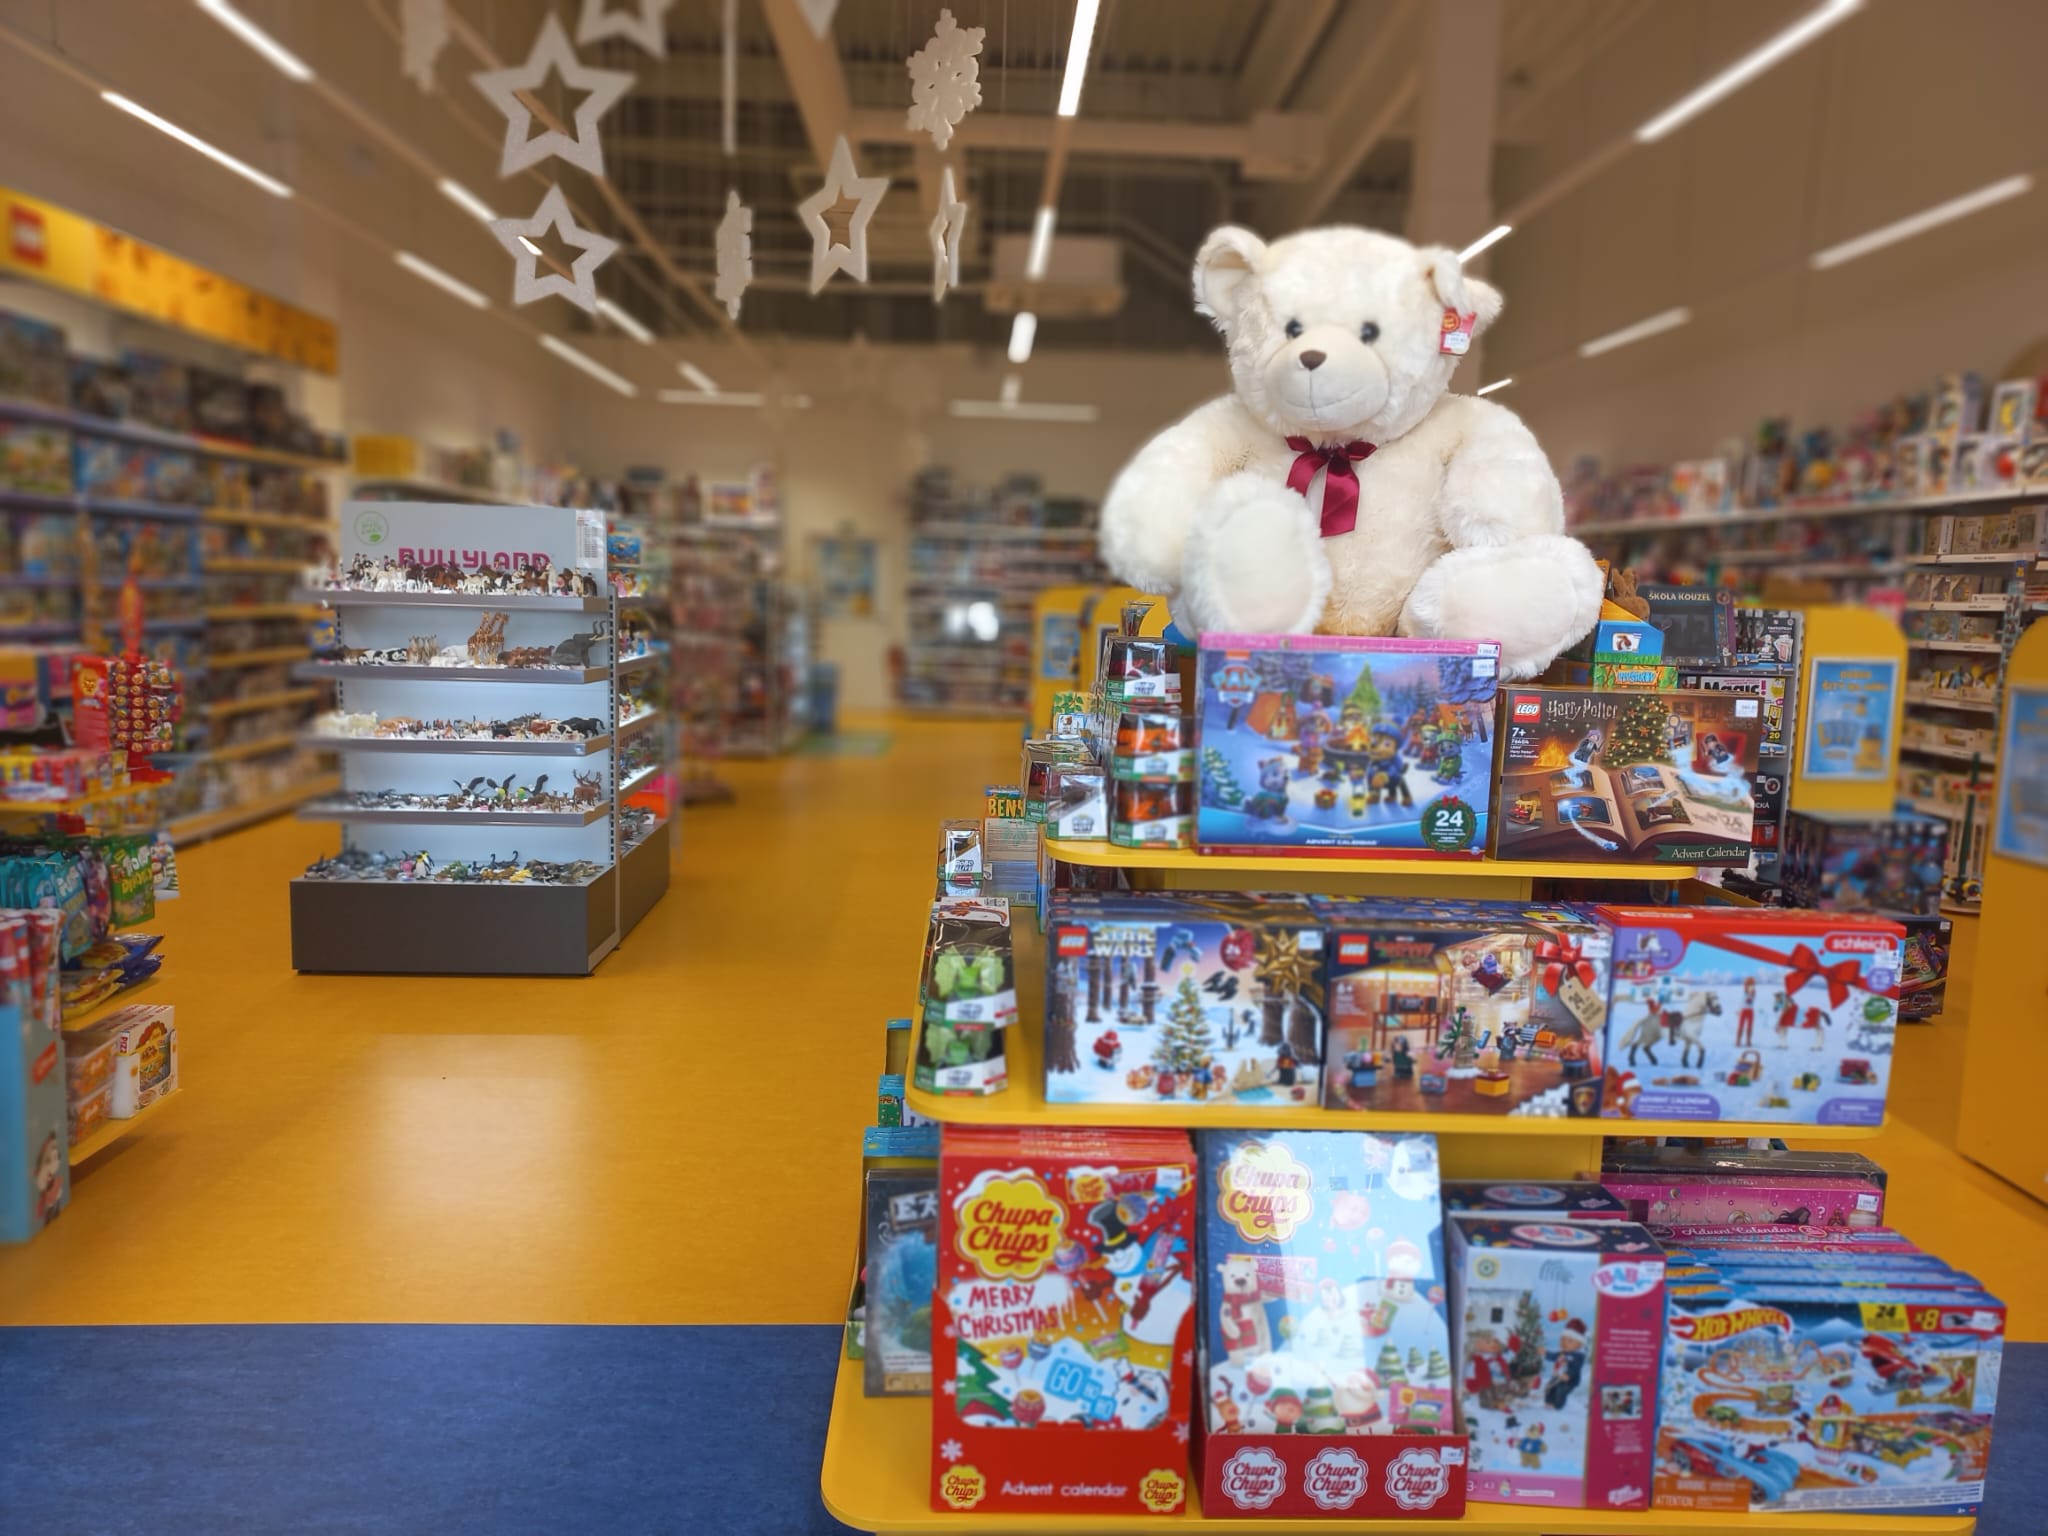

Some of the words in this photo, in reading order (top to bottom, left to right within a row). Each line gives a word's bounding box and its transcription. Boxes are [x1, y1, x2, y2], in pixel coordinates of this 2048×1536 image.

[397, 547, 550, 569] BULLYLAND
[1678, 592, 1711, 601] KOUZEL
[1515, 704, 1538, 715] LEGO
[1546, 699, 1582, 720] Harry
[1582, 698, 1618, 720] Potter
[1512, 727, 1526, 737] 7+
[1769, 732, 1780, 740] 20
[1435, 810, 1464, 828] 24
[1672, 848, 1704, 859] Advent
[1706, 847, 1747, 858] Calendar
[1089, 942, 1155, 957] WARS
[1832, 937, 1890, 950] schleich
[1233, 1165, 1302, 1193] Chupa
[973, 1200, 1054, 1232] Chupa
[1228, 1190, 1298, 1228] Chups
[1682, 1227, 1732, 1235] Advent
[1735, 1226, 1797, 1234] Calendar
[968, 1225, 1049, 1267] Chups
[968, 1285, 1036, 1308] MERRY
[958, 1305, 1058, 1339] CHRISTMAS
[1692, 1315, 1729, 1340] HOT
[1727, 1308, 1785, 1337] WHEELS
[1233, 1462, 1276, 1480] Chupa
[1315, 1462, 1358, 1480] Chupa
[1397, 1462, 1440, 1480] Chupa
[947, 1475, 979, 1488] Chupa
[1001, 1481, 1054, 1496] Advent
[1060, 1482, 1128, 1497] calendar
[1146, 1479, 1178, 1491] Chupa
[1230, 1476, 1275, 1499] Chups
[1312, 1476, 1356, 1499] Chups
[1393, 1476, 1437, 1499] Chups
[945, 1485, 978, 1502] Chups
[1144, 1489, 1177, 1505] Chups
